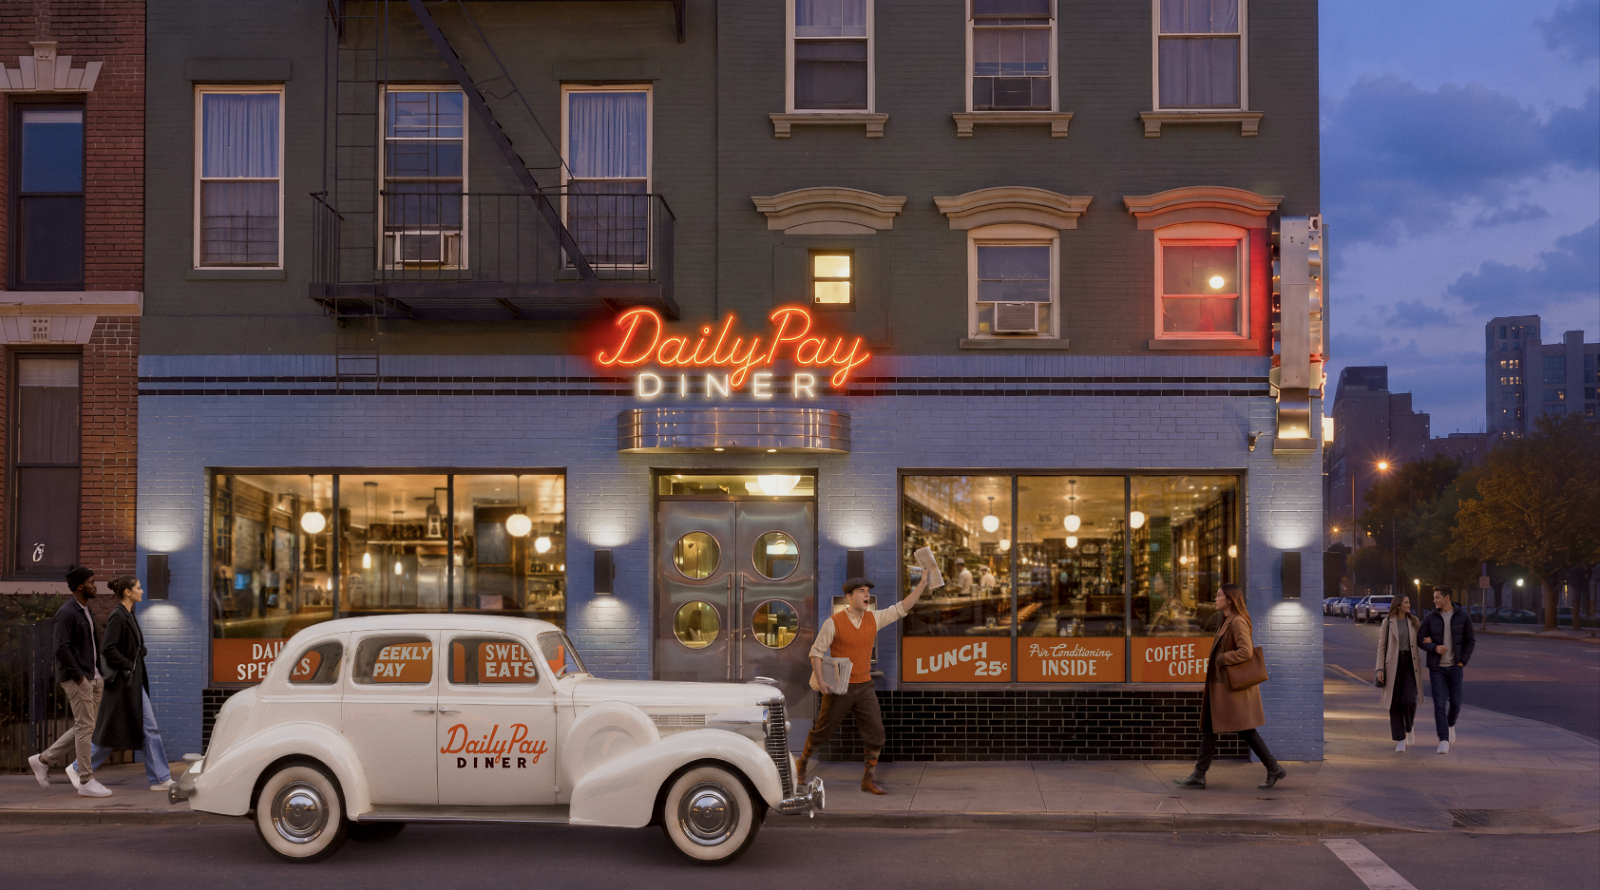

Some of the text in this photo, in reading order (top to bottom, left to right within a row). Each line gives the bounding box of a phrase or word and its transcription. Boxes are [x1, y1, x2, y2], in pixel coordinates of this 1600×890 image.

[638, 373, 815, 398] DINER
[379, 646, 432, 660] EEKLY
[485, 644, 532, 660] SWEL
[916, 642, 988, 674] LUNCH
[1029, 643, 1113, 660] Air Conditioning
[1145, 643, 1195, 662] COFFEE
[373, 662, 406, 677] PAY
[485, 662, 536, 677] EATS
[974, 661, 1008, 676] 25¢
[1042, 659, 1097, 676] INSIDE
[457, 757, 527, 769] DINER
